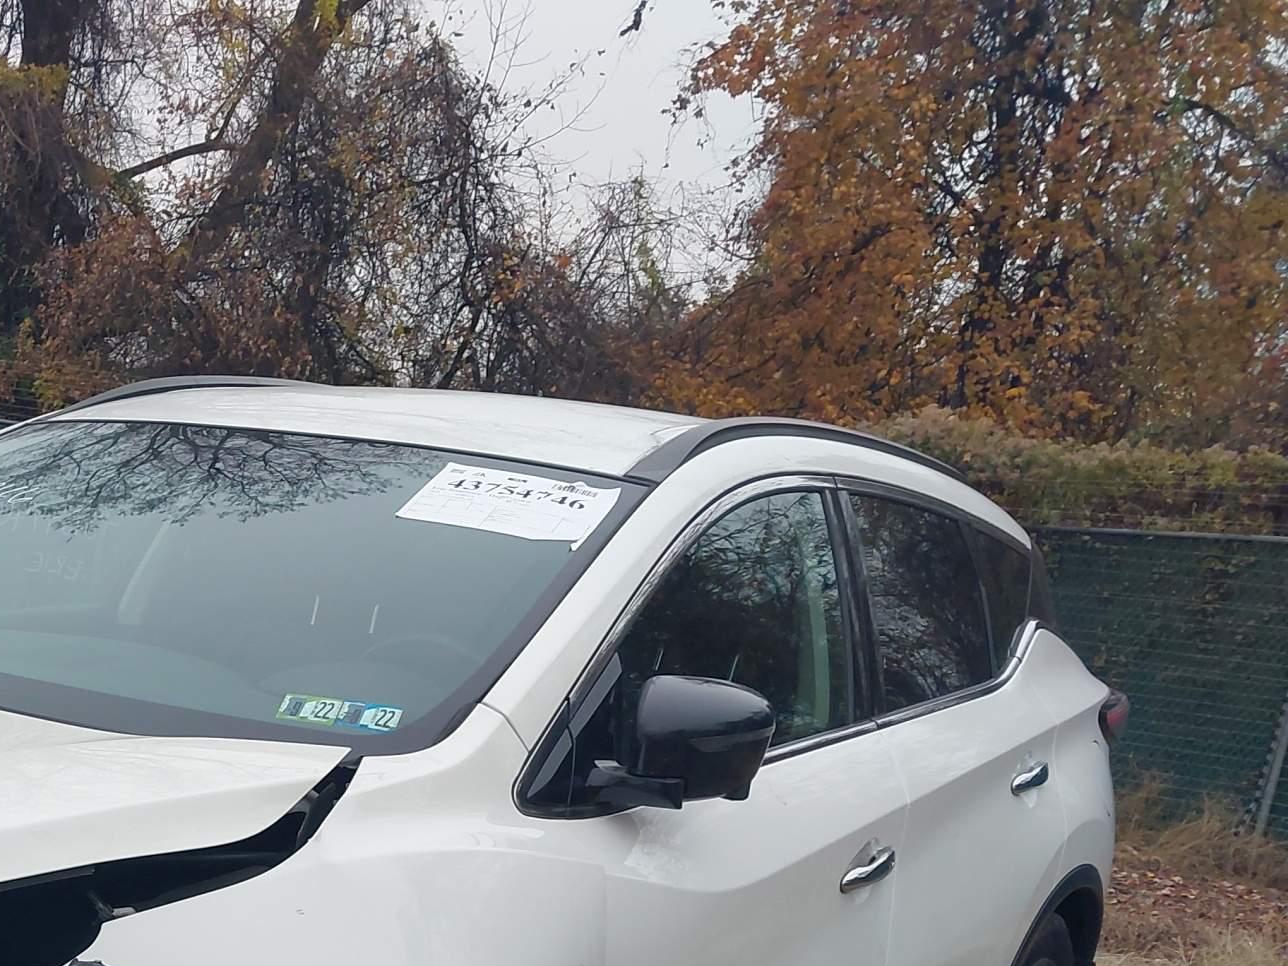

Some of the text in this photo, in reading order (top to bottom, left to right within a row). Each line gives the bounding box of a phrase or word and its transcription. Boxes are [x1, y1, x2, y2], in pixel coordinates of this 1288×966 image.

[447, 477, 585, 510] 43754746
[314, 701, 335, 720] 22
[375, 709, 396, 729] 22
